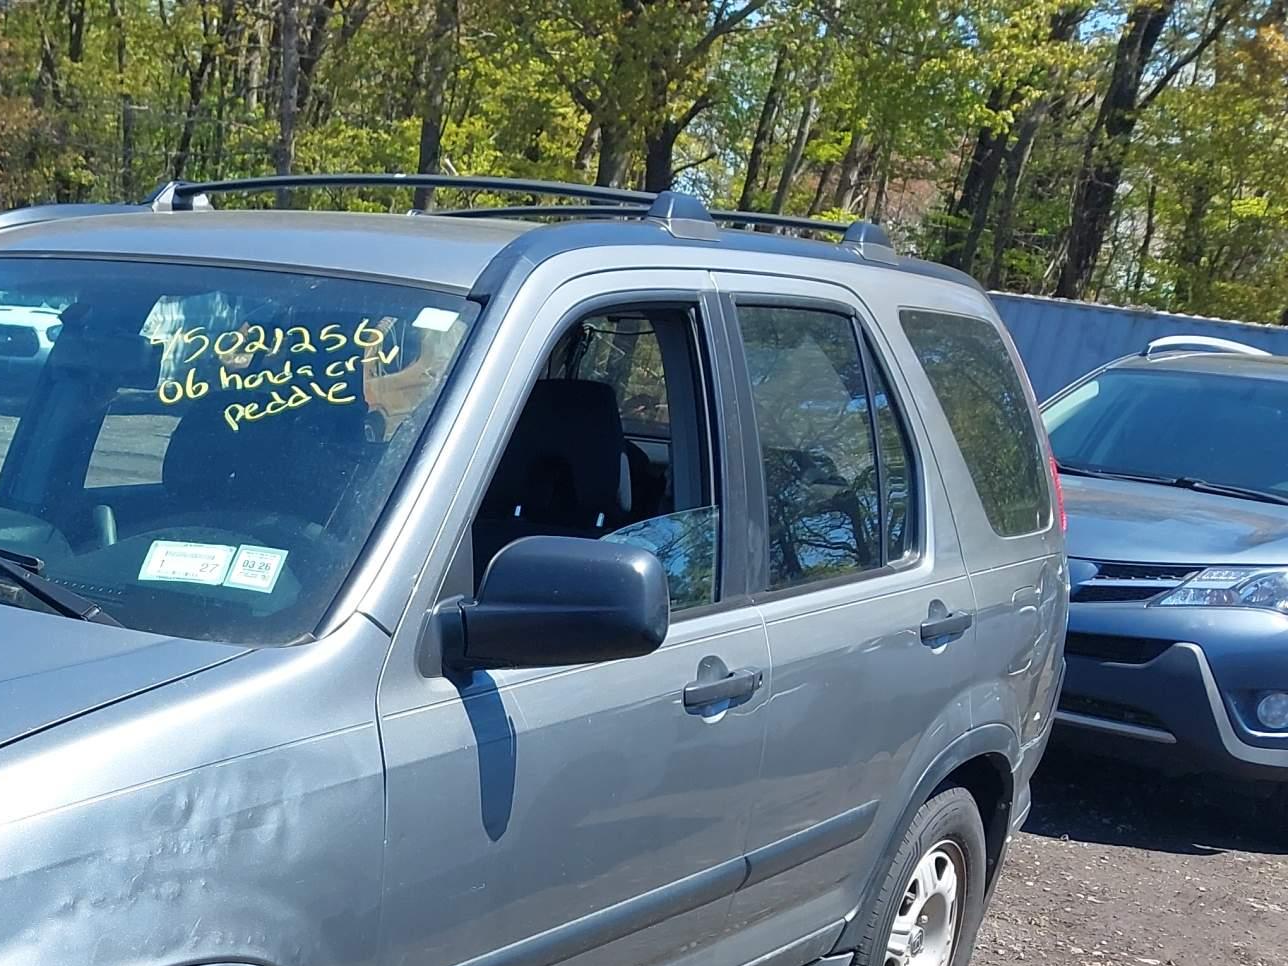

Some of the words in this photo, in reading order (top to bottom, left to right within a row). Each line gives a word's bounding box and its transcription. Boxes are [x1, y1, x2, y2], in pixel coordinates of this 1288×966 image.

[150, 317, 385, 364] 45021256
[158, 367, 210, 405] 06
[220, 360, 315, 391] honda
[223, 381, 357, 432] peddle
[200, 563, 220, 574] 27
[242, 559, 255, 570] 03
[258, 560, 272, 572] 26
